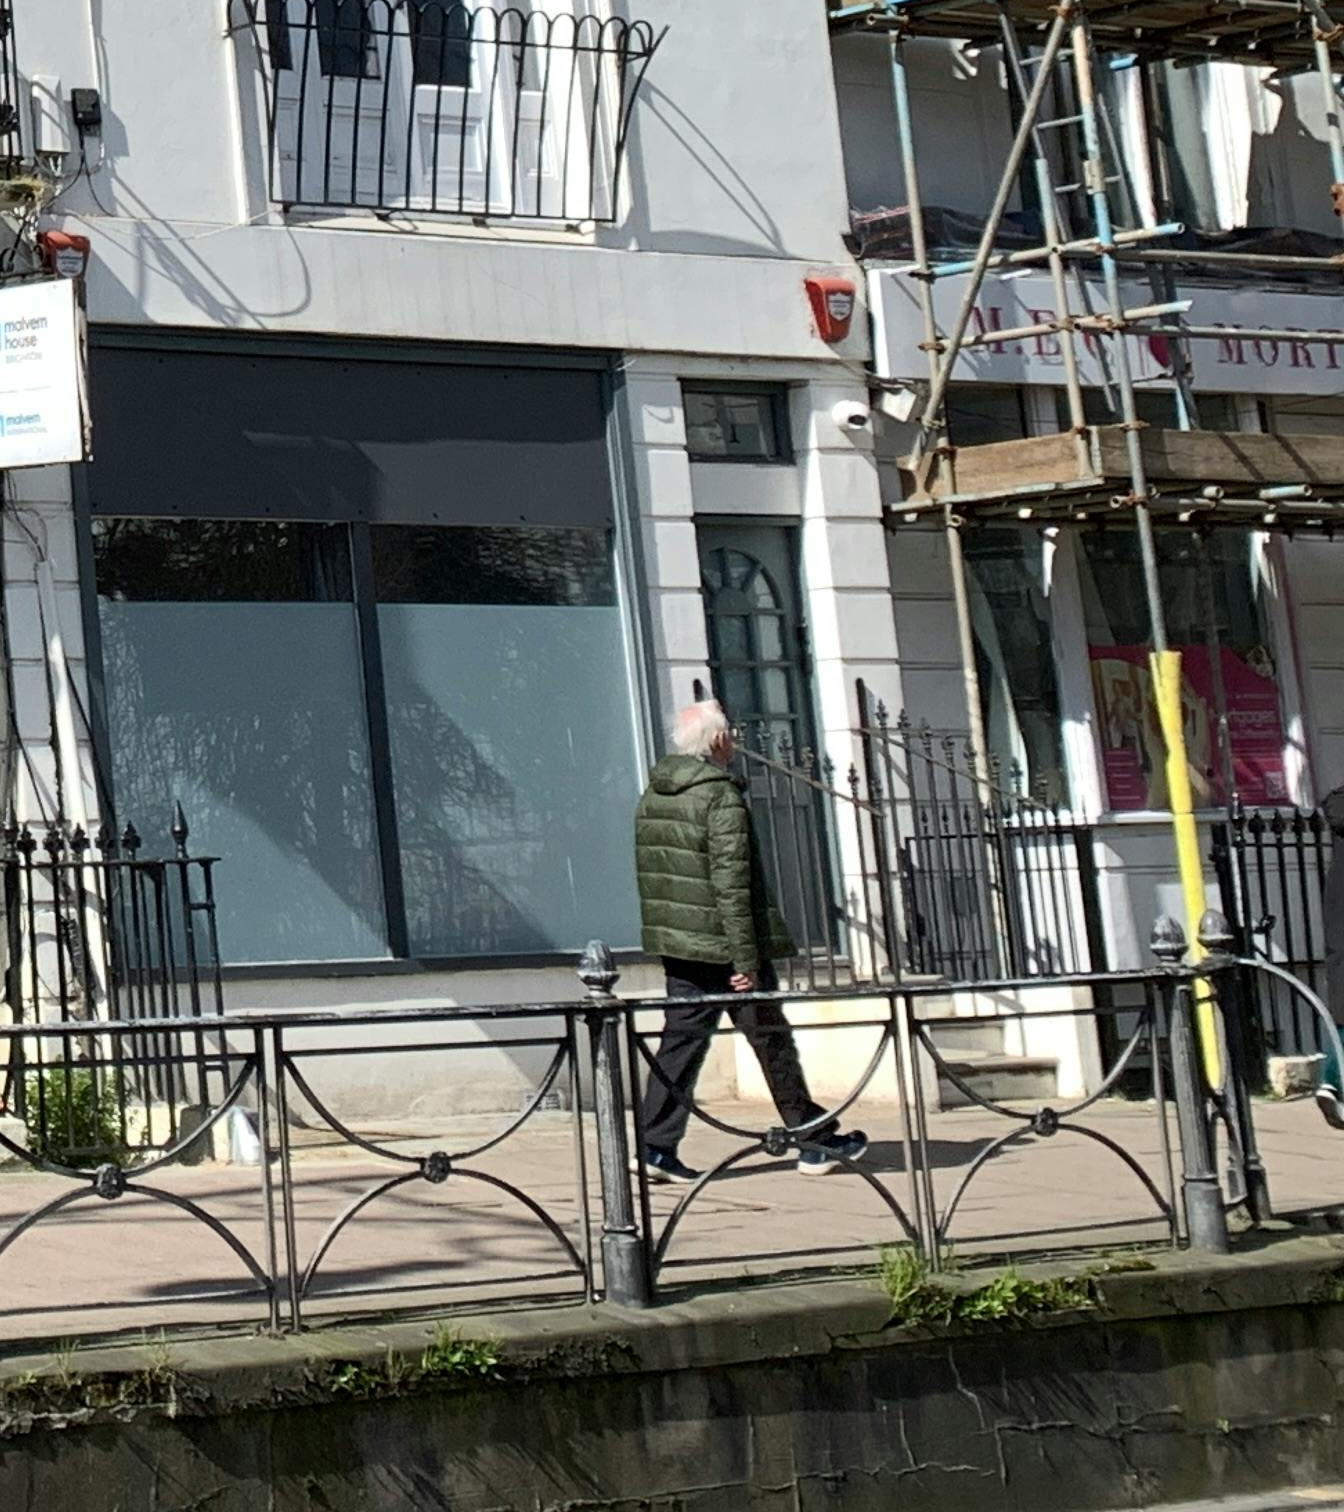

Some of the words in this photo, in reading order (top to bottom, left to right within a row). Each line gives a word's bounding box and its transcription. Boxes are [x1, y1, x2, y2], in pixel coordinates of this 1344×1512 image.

[4, 317, 48, 332] malvern
[5, 335, 38, 350] house
[6, 413, 41, 425] malvern
